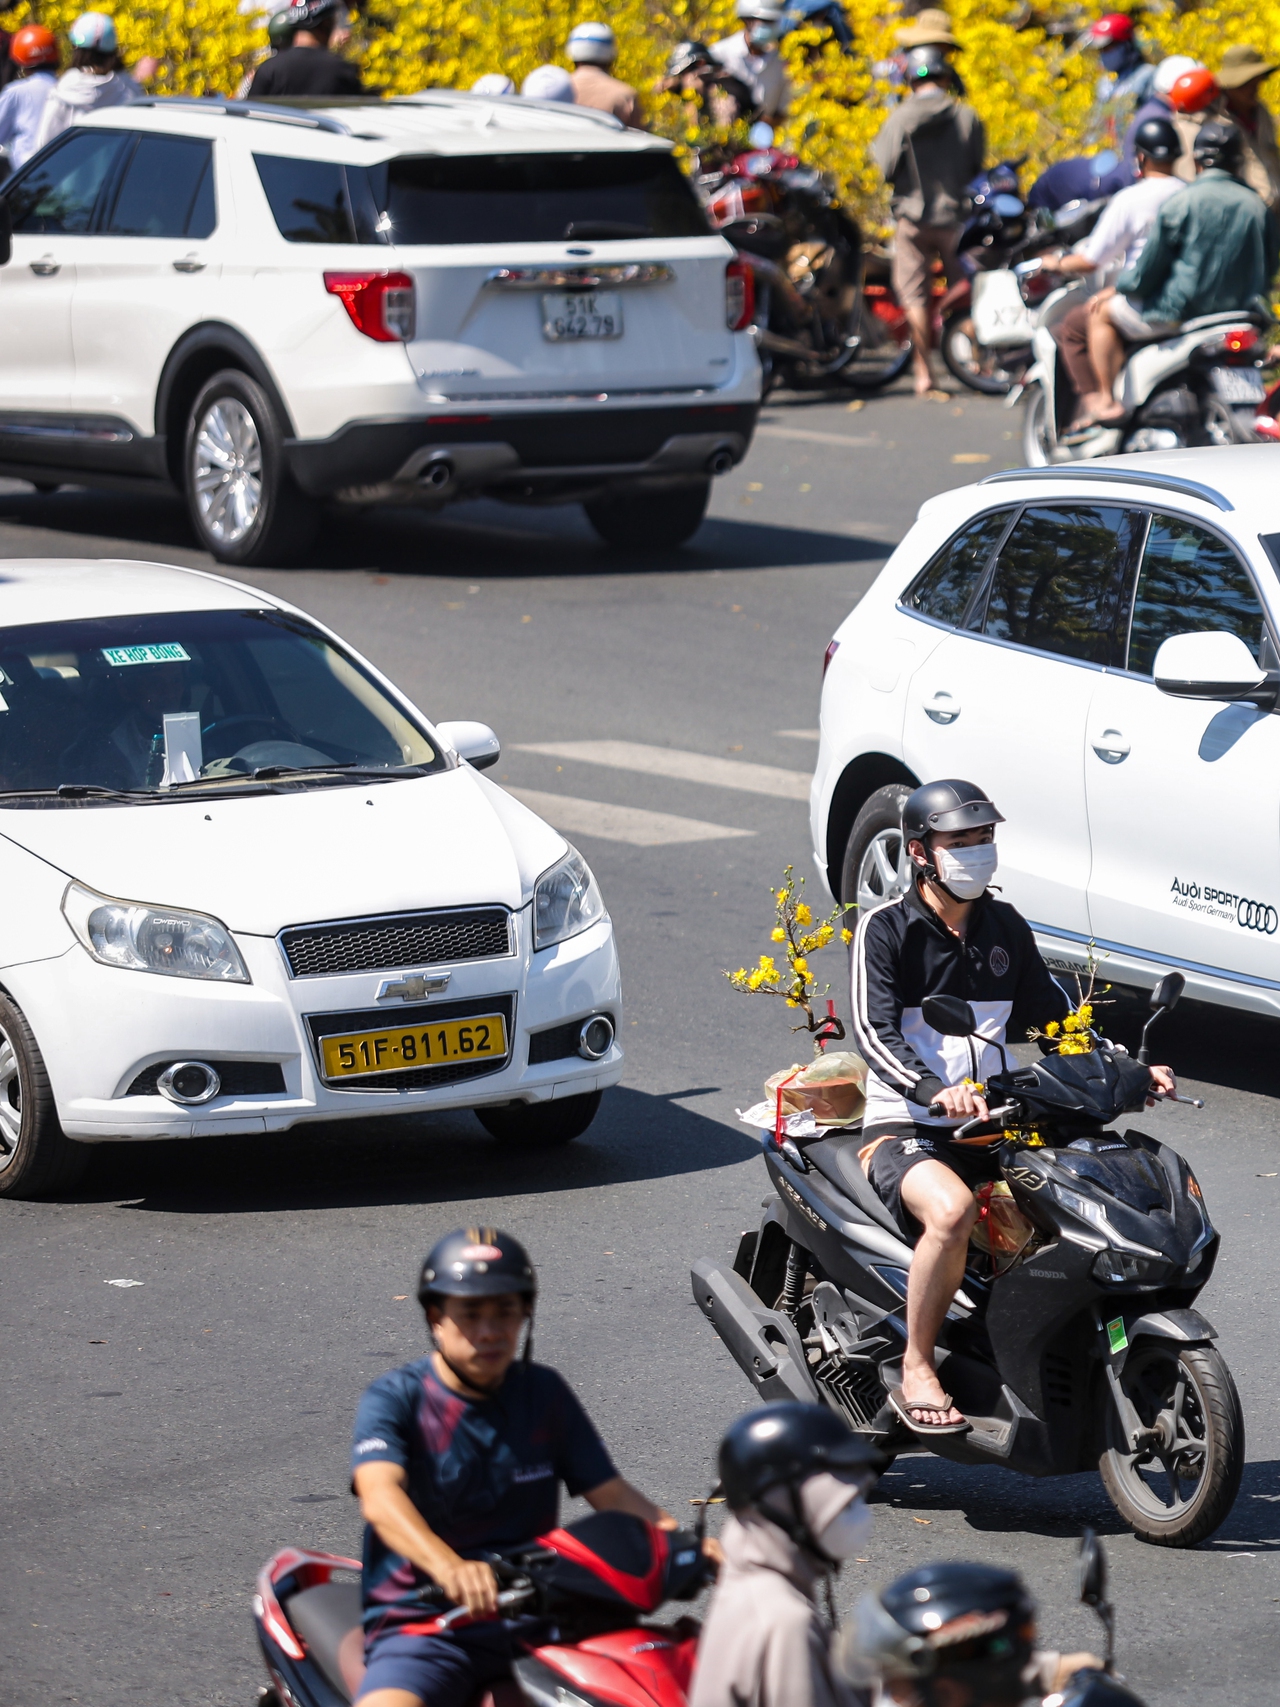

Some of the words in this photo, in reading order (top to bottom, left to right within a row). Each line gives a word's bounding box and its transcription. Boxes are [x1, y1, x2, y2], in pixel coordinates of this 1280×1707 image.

[106, 650, 127, 663] XE
[1204, 886, 1239, 909] SPORT
[1172, 896, 1189, 908] Audi
[1206, 904, 1237, 924] Germany
[337, 1024, 491, 1070] 51F-811.62
[1029, 1268, 1068, 1280] HONDA
